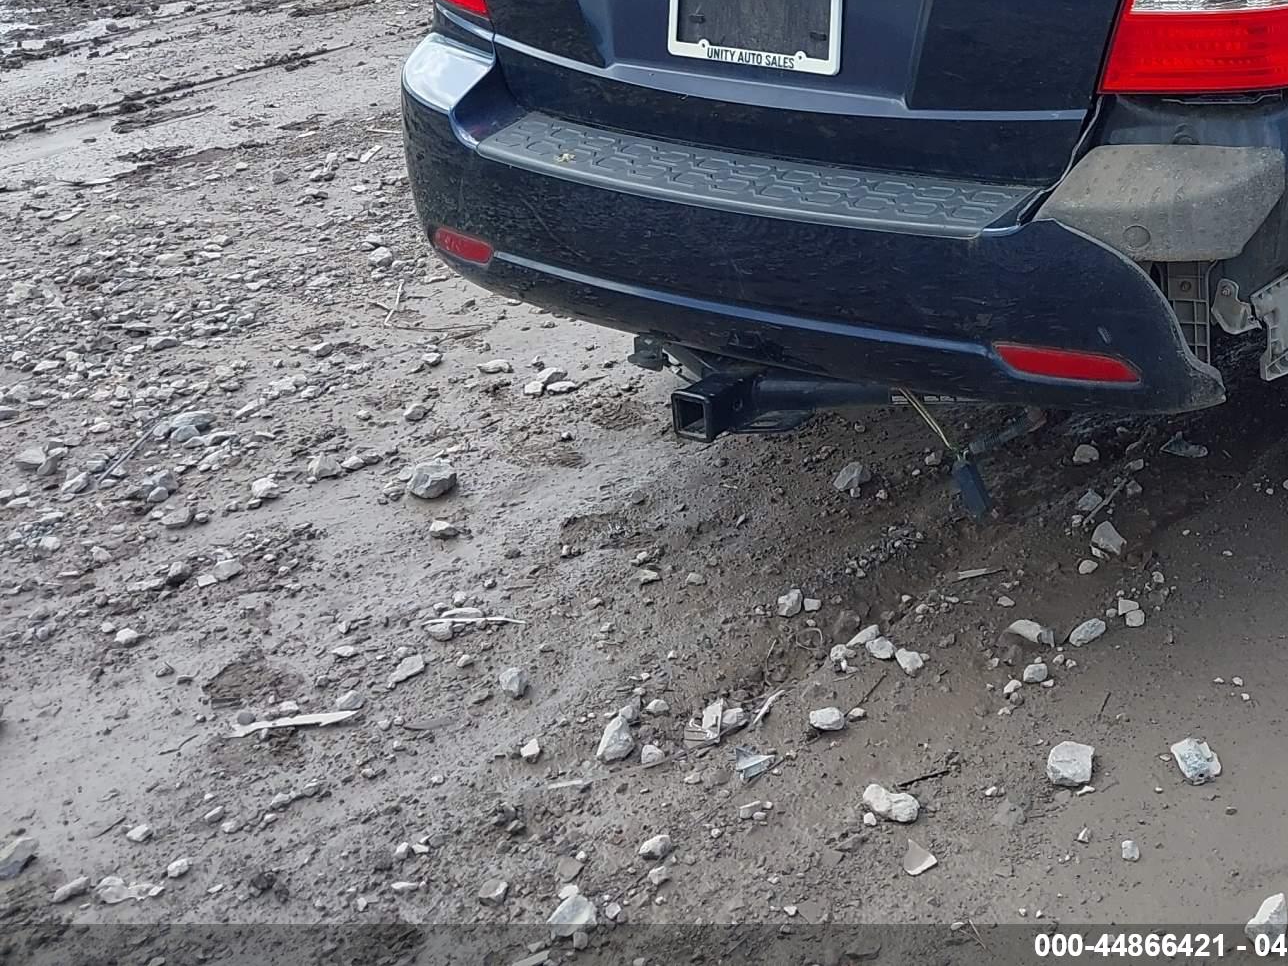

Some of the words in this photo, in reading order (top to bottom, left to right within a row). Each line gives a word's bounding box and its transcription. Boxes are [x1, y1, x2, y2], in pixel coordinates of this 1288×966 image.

[707, 47, 736, 60] UNITY
[737, 51, 763, 65] AUTO
[764, 55, 795, 69] SALES
